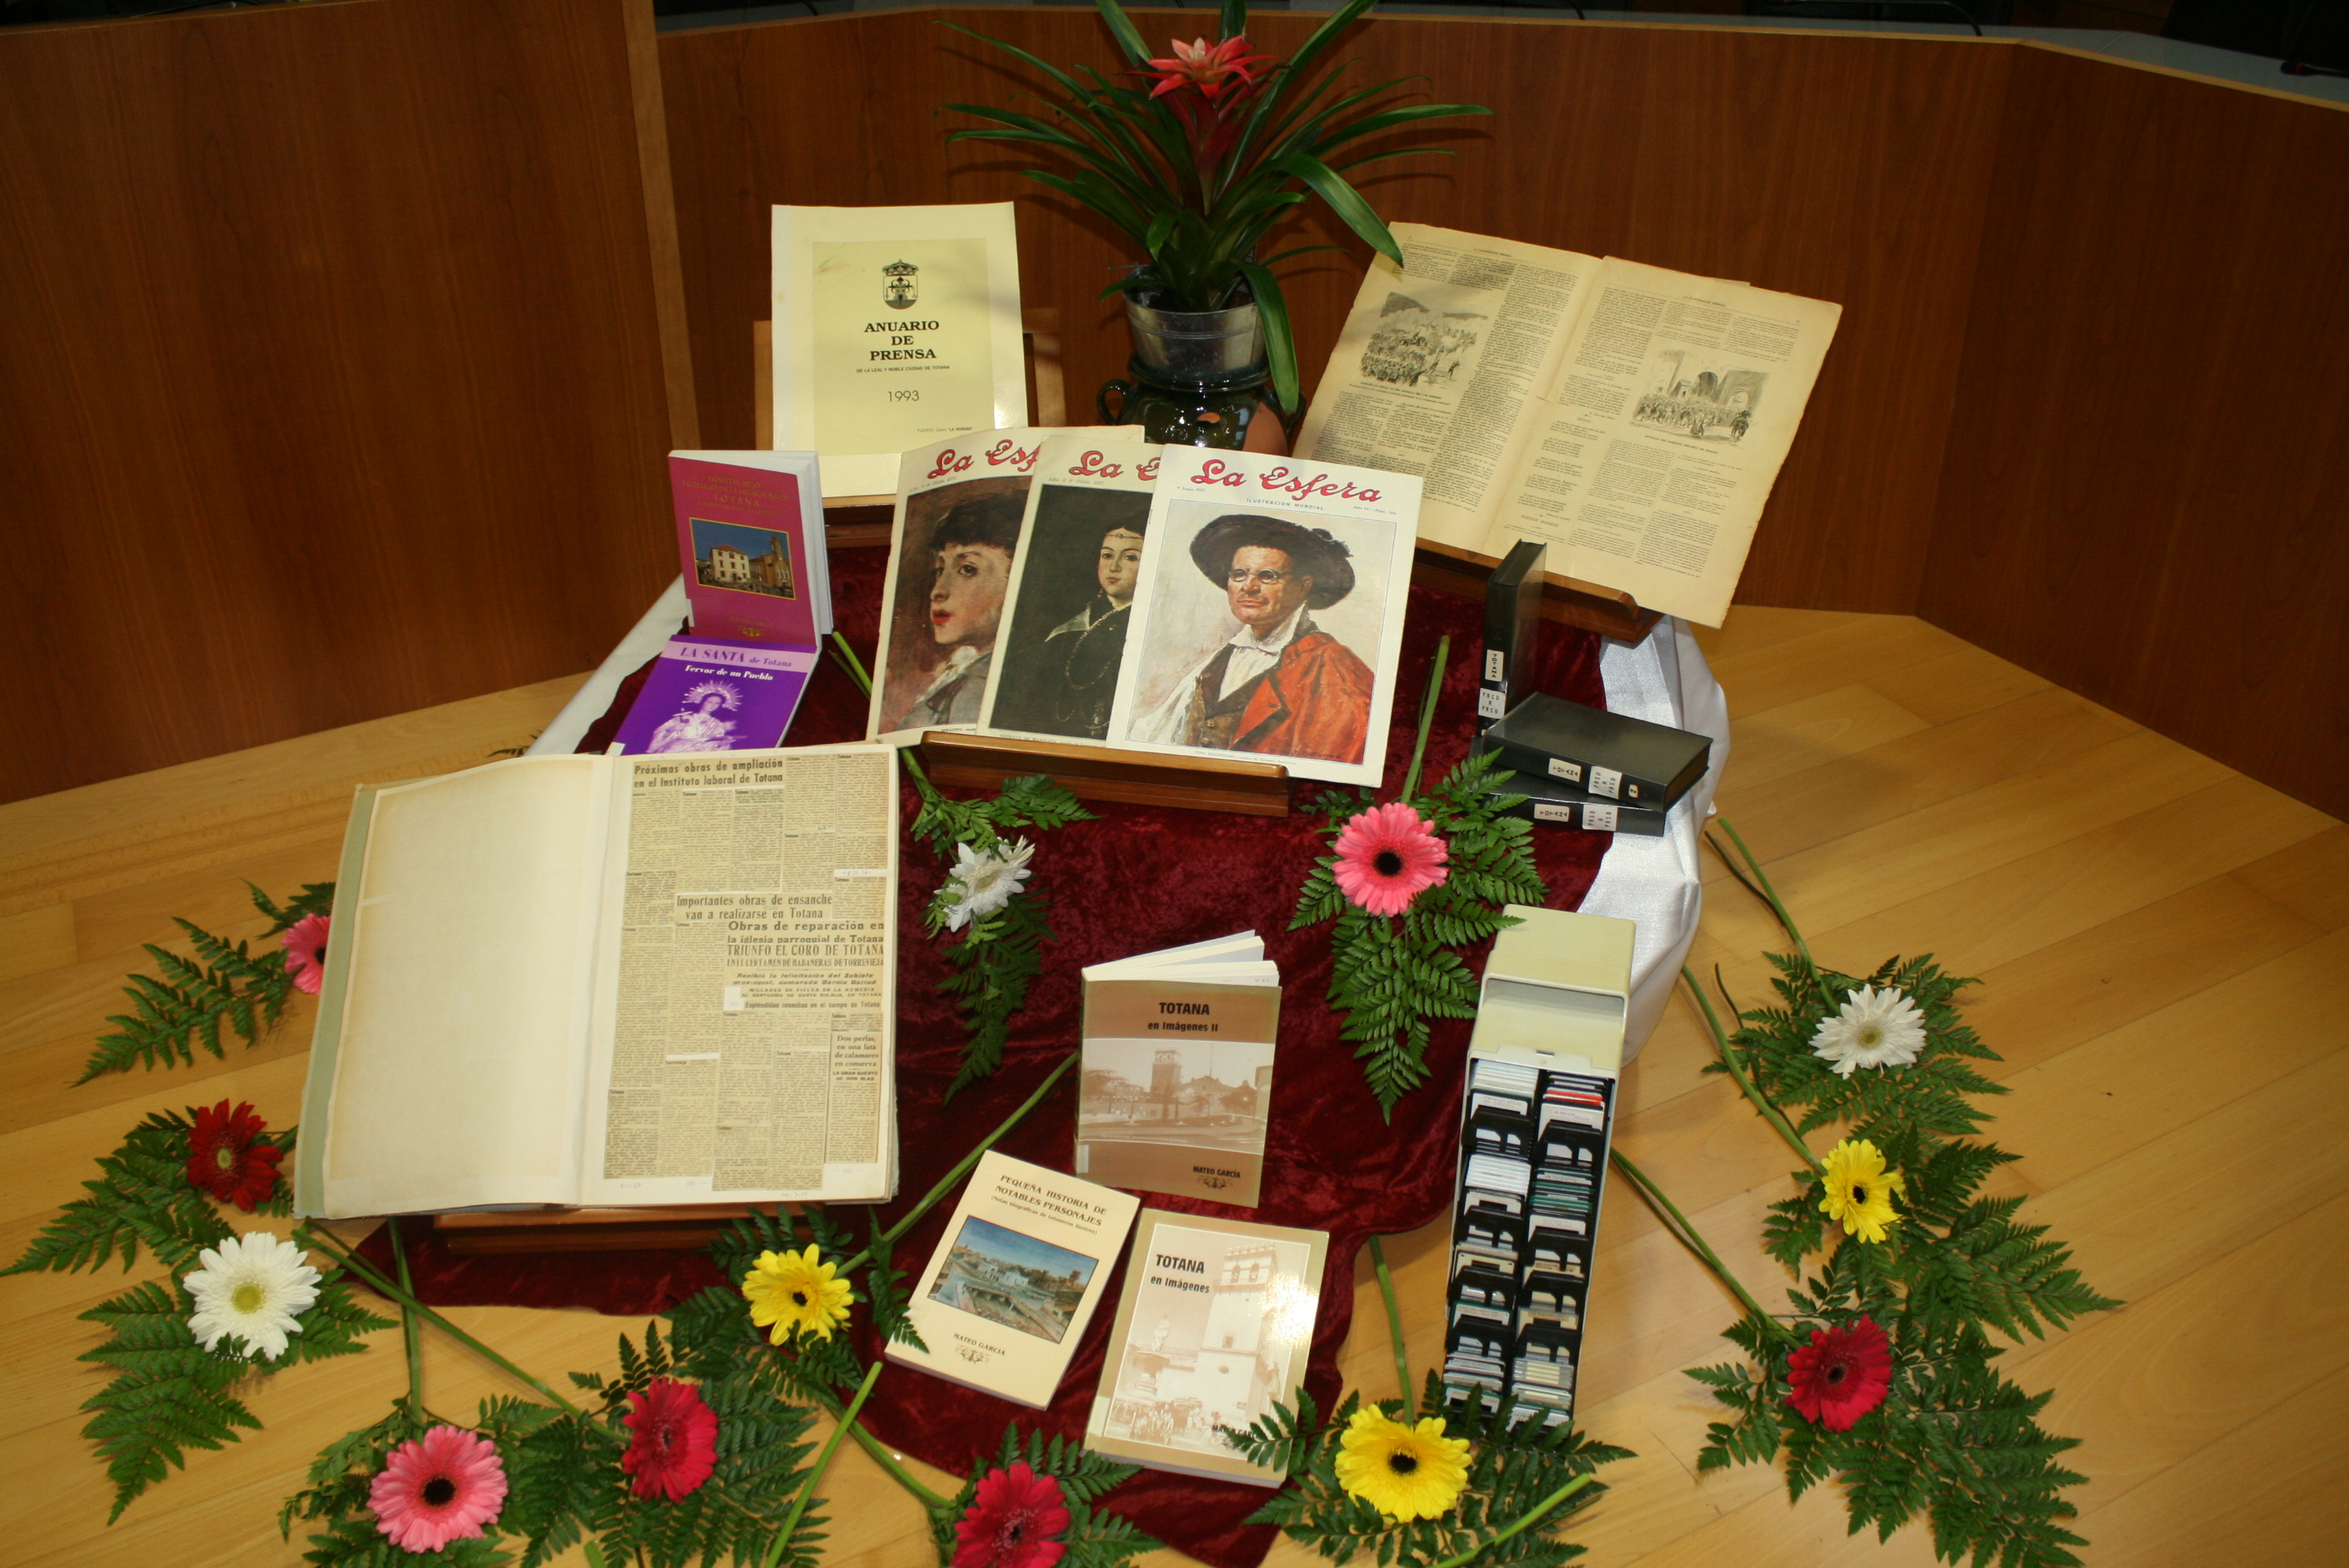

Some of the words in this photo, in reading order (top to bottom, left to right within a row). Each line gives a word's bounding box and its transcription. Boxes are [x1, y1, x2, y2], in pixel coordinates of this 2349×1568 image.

[864, 320, 939, 333] ANUARIO
[891, 335, 914, 345] DE
[870, 349, 937, 361] PRENSA
[888, 389, 920, 402] 1993
[927, 449, 974, 480] La
[984, 439, 1041, 472] Esf
[1069, 450, 1124, 478] La
[1190, 459, 1246, 487] La
[1259, 466, 1382, 502] Esfera
[1246, 498, 1291, 506] ILUSTRACION
[680, 647, 697, 657] LA
[702, 650, 745, 662] SANTA
[762, 657, 792, 667] Totana
[685, 665, 716, 674] Fervor
[743, 671, 773, 681] Pueblo
[634, 764, 679, 775] Próximas
[684, 762, 711, 772] obras
[716, 761, 727, 771] de
[732, 759, 783, 772] ampliación
[1552, 766, 1579, 777] TOTANA
[634, 780, 644, 788] en
[648, 777, 656, 787] el
[661, 776, 700, 787] Instituto
[704, 774, 736, 786] laboral
[739, 773, 750, 784] de
[754, 772, 783, 782] Totana
[677, 895, 734, 909] Importantes
[739, 894, 766, 906] obras
[771, 895, 782, 906] de
[787, 894, 832, 906] ensanche
[686, 912, 702, 920] van
[719, 909, 767, 920] realizarse
[772, 911, 784, 919] en
[789, 907, 822, 919] Totana
[728, 921, 768, 931] Obras
[774, 921, 789, 931] de
[794, 921, 864, 932] reparación
[870, 922, 884, 931] en
[727, 935, 737, 943] la
[741, 935, 773, 944] iglesia
[849, 934, 884, 942] Totana
[727, 944, 772, 956] TRIUNFO
[776, 944, 787, 956] EL
[791, 944, 819, 956] CORO
[825, 944, 839, 956] DE
[843, 944, 884, 956] TOTANA
[834, 958, 843, 967] DE
[844, 958, 884, 967] TORREVIEJA
[1159, 1003, 1210, 1016] TOTANA
[1211, 1023, 1218, 1032] II
[1193, 1166, 1215, 1175] MATEO
[999, 1174, 1042, 1194] PEQUEÑA
[1046, 1189, 1089, 1209] HISTORIA
[1093, 1206, 1107, 1216] DE
[994, 1185, 1042, 1206] NOTABLES
[1043, 1201, 1103, 1226] PERSONAJES
[1156, 1254, 1205, 1274] TOTANA
[1150, 1276, 1163, 1285] en
[953, 1333, 978, 1346] MATEO
[978, 1342, 1006, 1356] GARCIA
